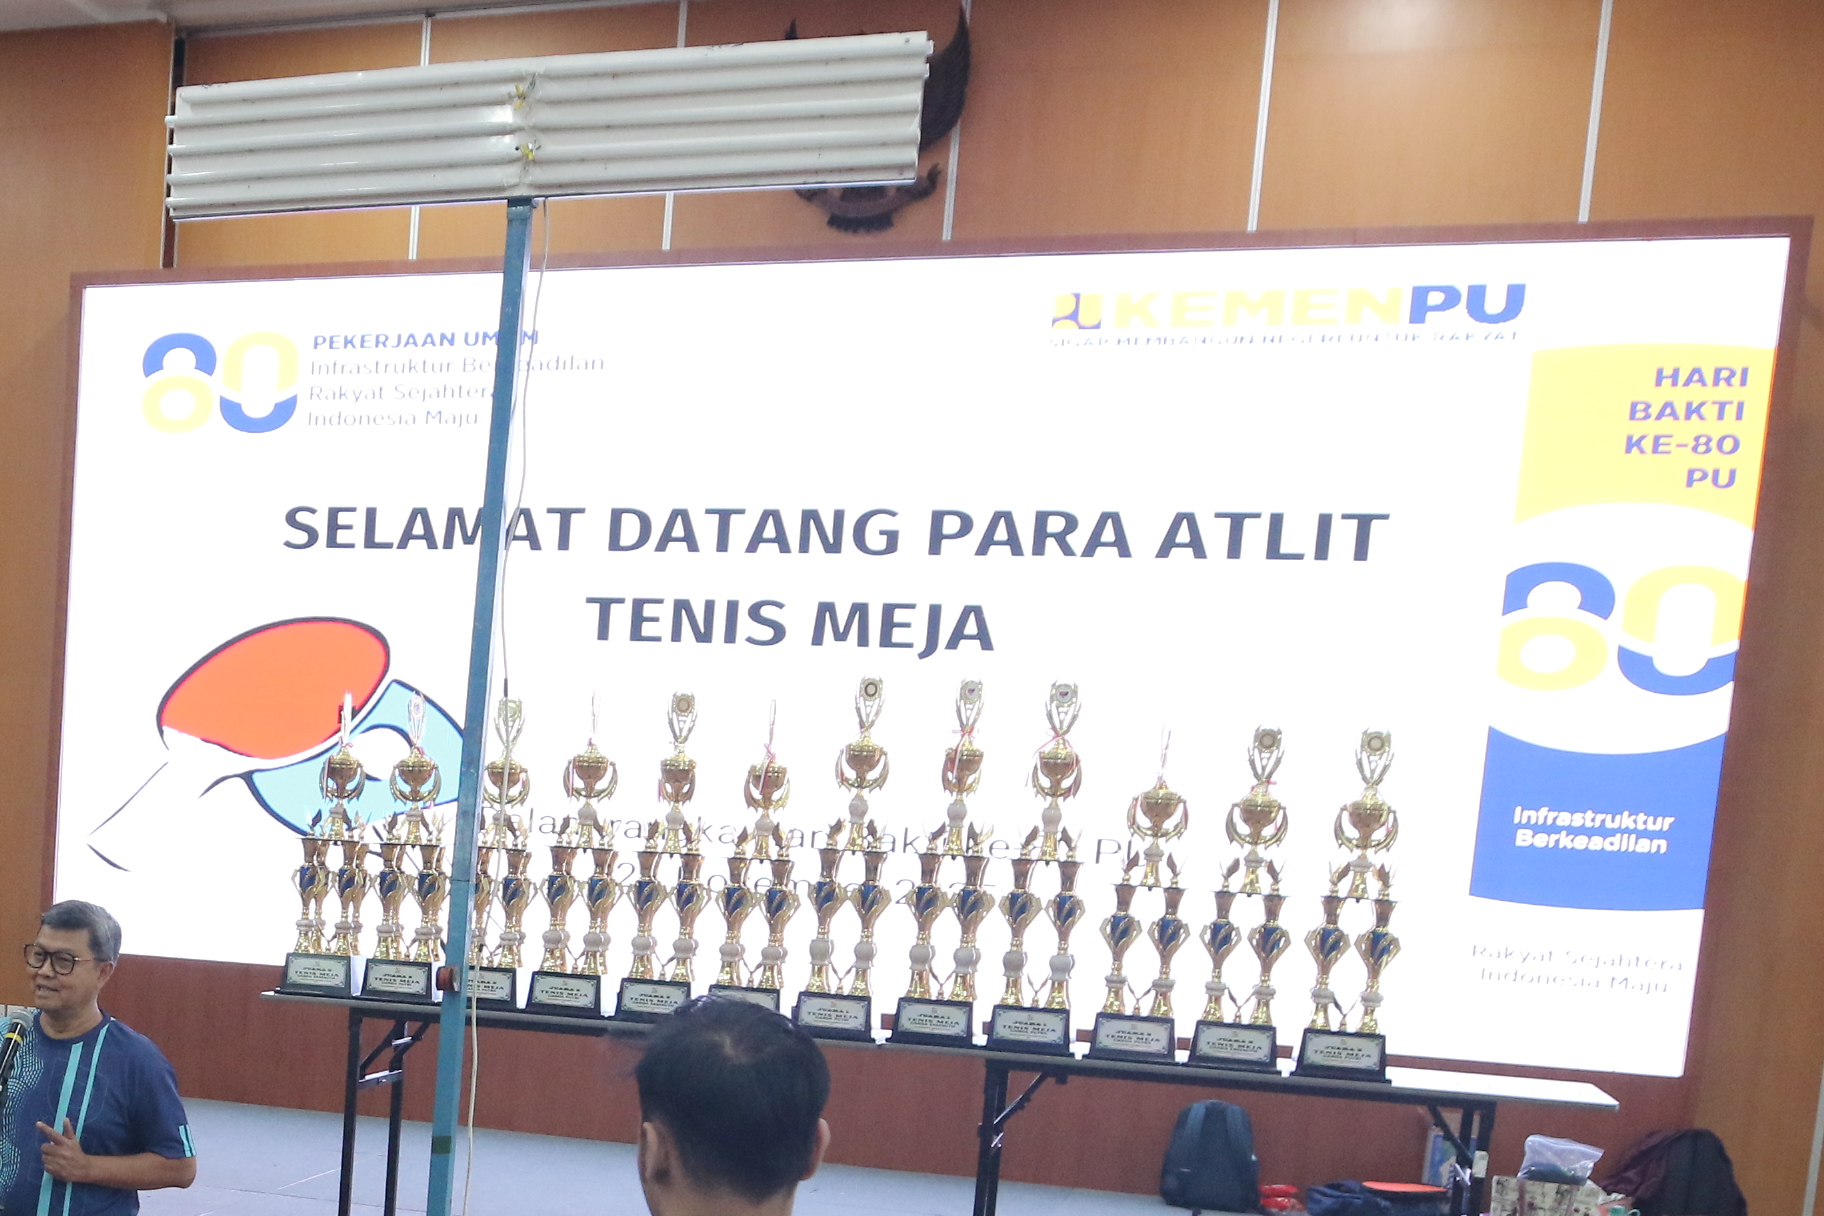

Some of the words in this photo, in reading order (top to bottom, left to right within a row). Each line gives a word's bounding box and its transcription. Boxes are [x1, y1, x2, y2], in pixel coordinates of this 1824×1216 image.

[1113, 283, 1527, 329] KEMENPU
[312, 331, 456, 350] PEKERJAAN
[463, 329, 539, 347] UMM
[310, 357, 454, 376] Infrastruktur
[462, 354, 605, 373] Beeadilan
[1654, 366, 1750, 388] HARI
[309, 384, 384, 403] Rakyat
[393, 382, 496, 402] Sejahter
[307, 410, 416, 427] Indonesia
[425, 409, 479, 428] Maju
[1628, 399, 1746, 422] BAKTI
[1624, 433, 1742, 456] KE-80
[1685, 467, 1738, 490] PU
[606, 507, 901, 556] DATANG
[926, 508, 1134, 559] PARA
[1154, 510, 1391, 563] ATLIT
[585, 596, 787, 648] TENIS
[811, 600, 996, 661] MEJA
[1512, 804, 1676, 832] Infrastruktur
[1514, 827, 1669, 855] Berkeadilan
[1471, 944, 1554, 964] Rakyat
[1565, 949, 1684, 971] Sejahtera
[1480, 966, 1601, 989] Indonesia
[1610, 976, 1669, 995] Maju
